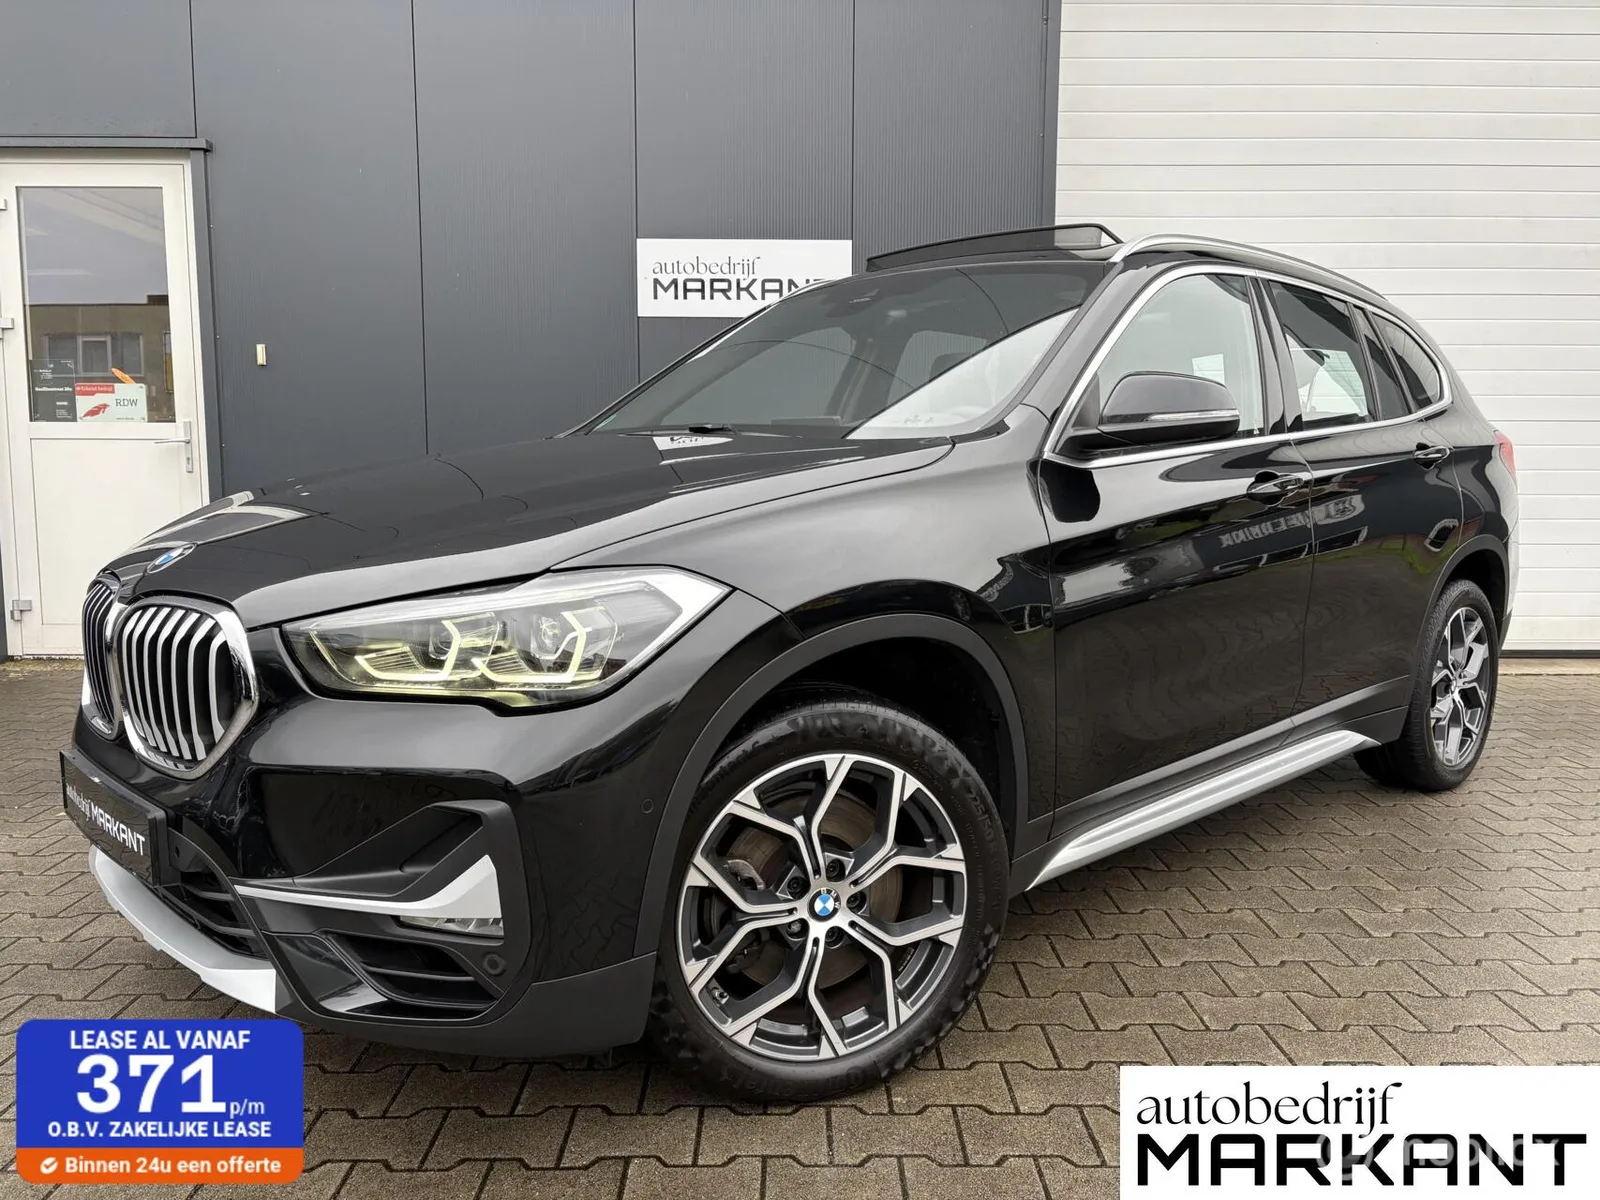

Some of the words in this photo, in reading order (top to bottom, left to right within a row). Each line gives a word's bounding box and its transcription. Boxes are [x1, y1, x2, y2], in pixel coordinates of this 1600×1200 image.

[652, 256, 761, 279] autobedrijf
[653, 278, 825, 301] MARKA
[115, 398, 138, 407] RDW
[91, 802, 145, 856] MARKANT
